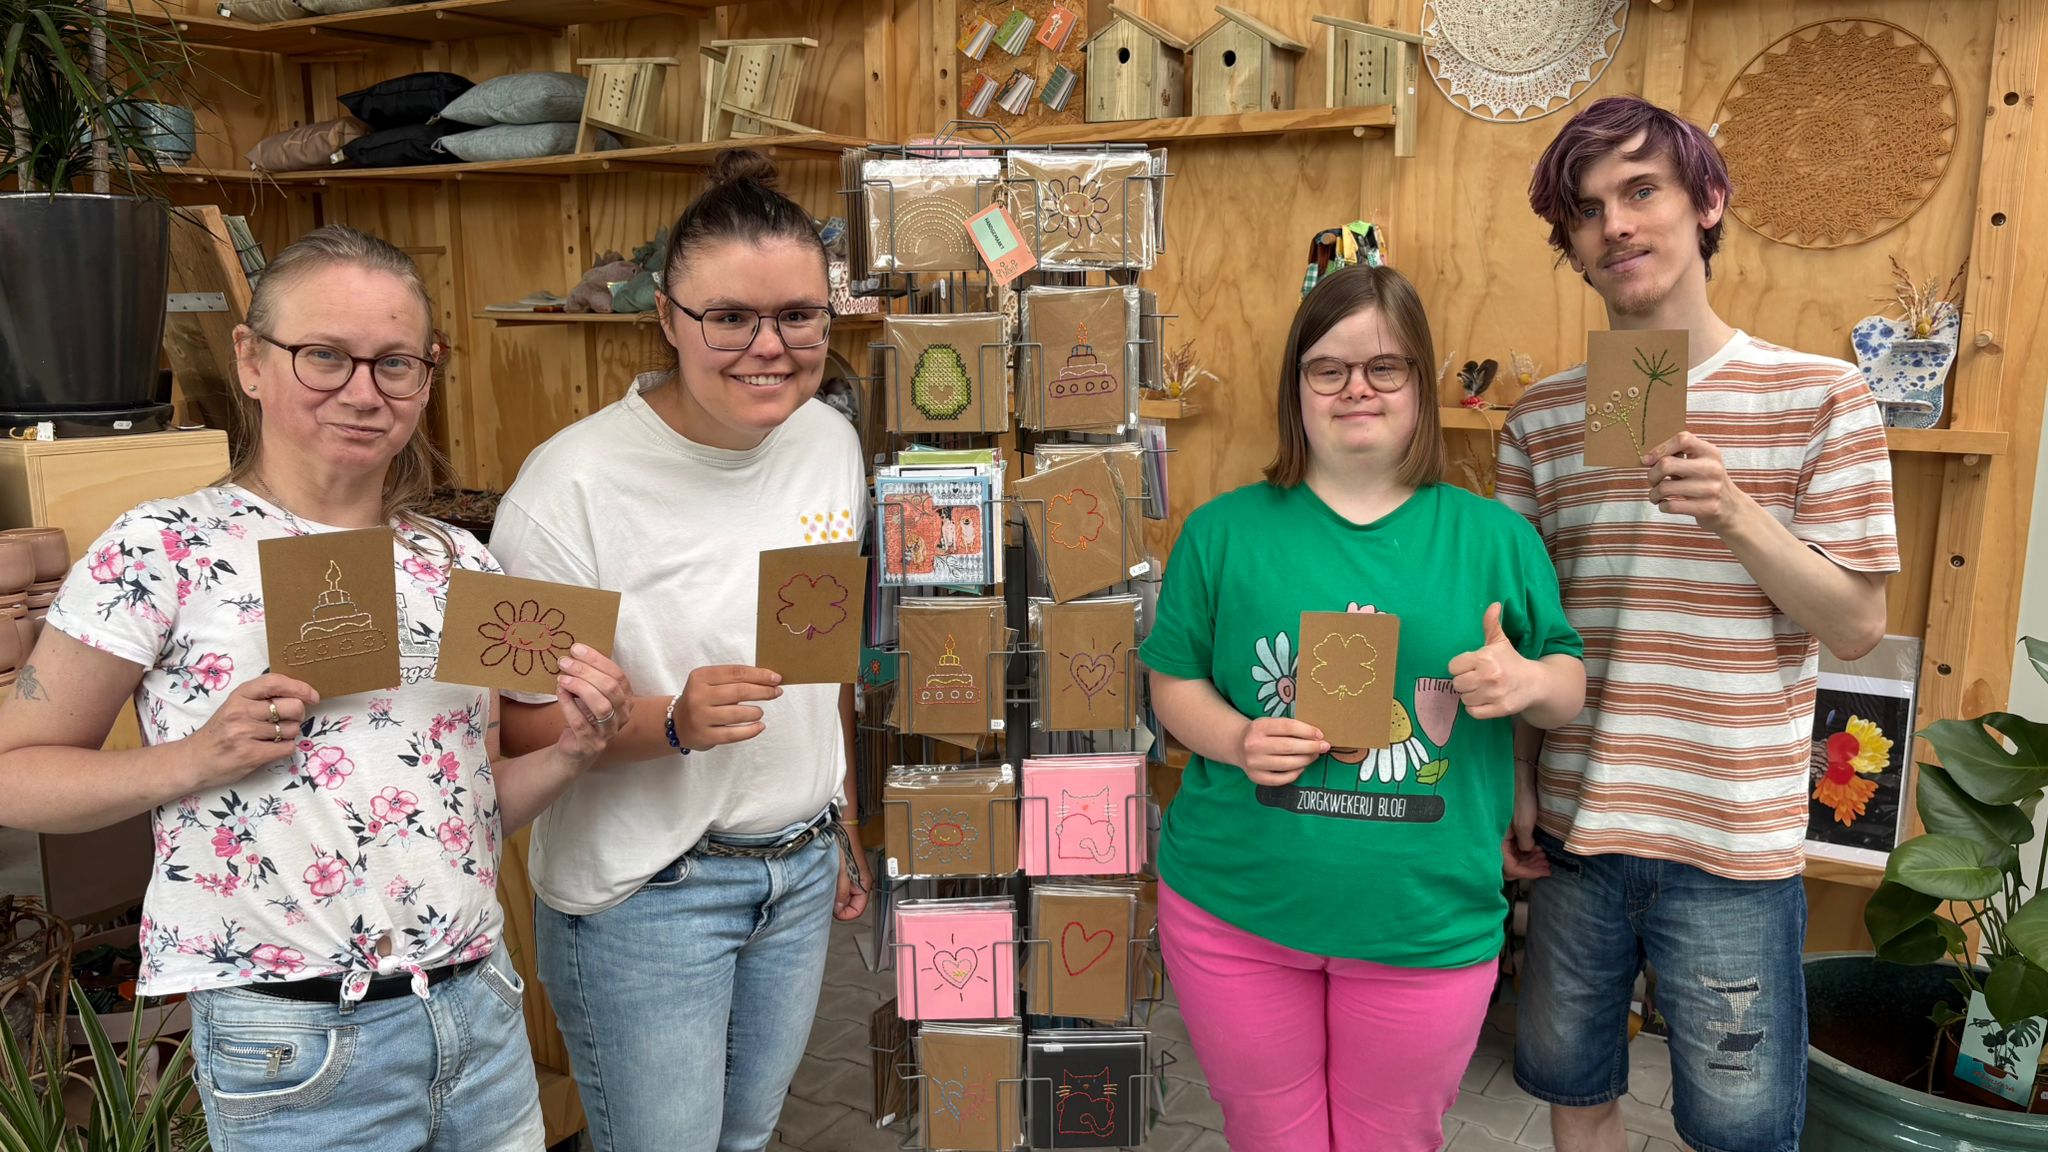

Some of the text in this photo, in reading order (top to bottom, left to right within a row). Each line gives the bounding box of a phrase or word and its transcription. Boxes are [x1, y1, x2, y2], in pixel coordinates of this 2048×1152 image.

[400, 662, 437, 684] ngel
[1297, 791, 1407, 818] ZORGKWEKERIJ BLOEI
